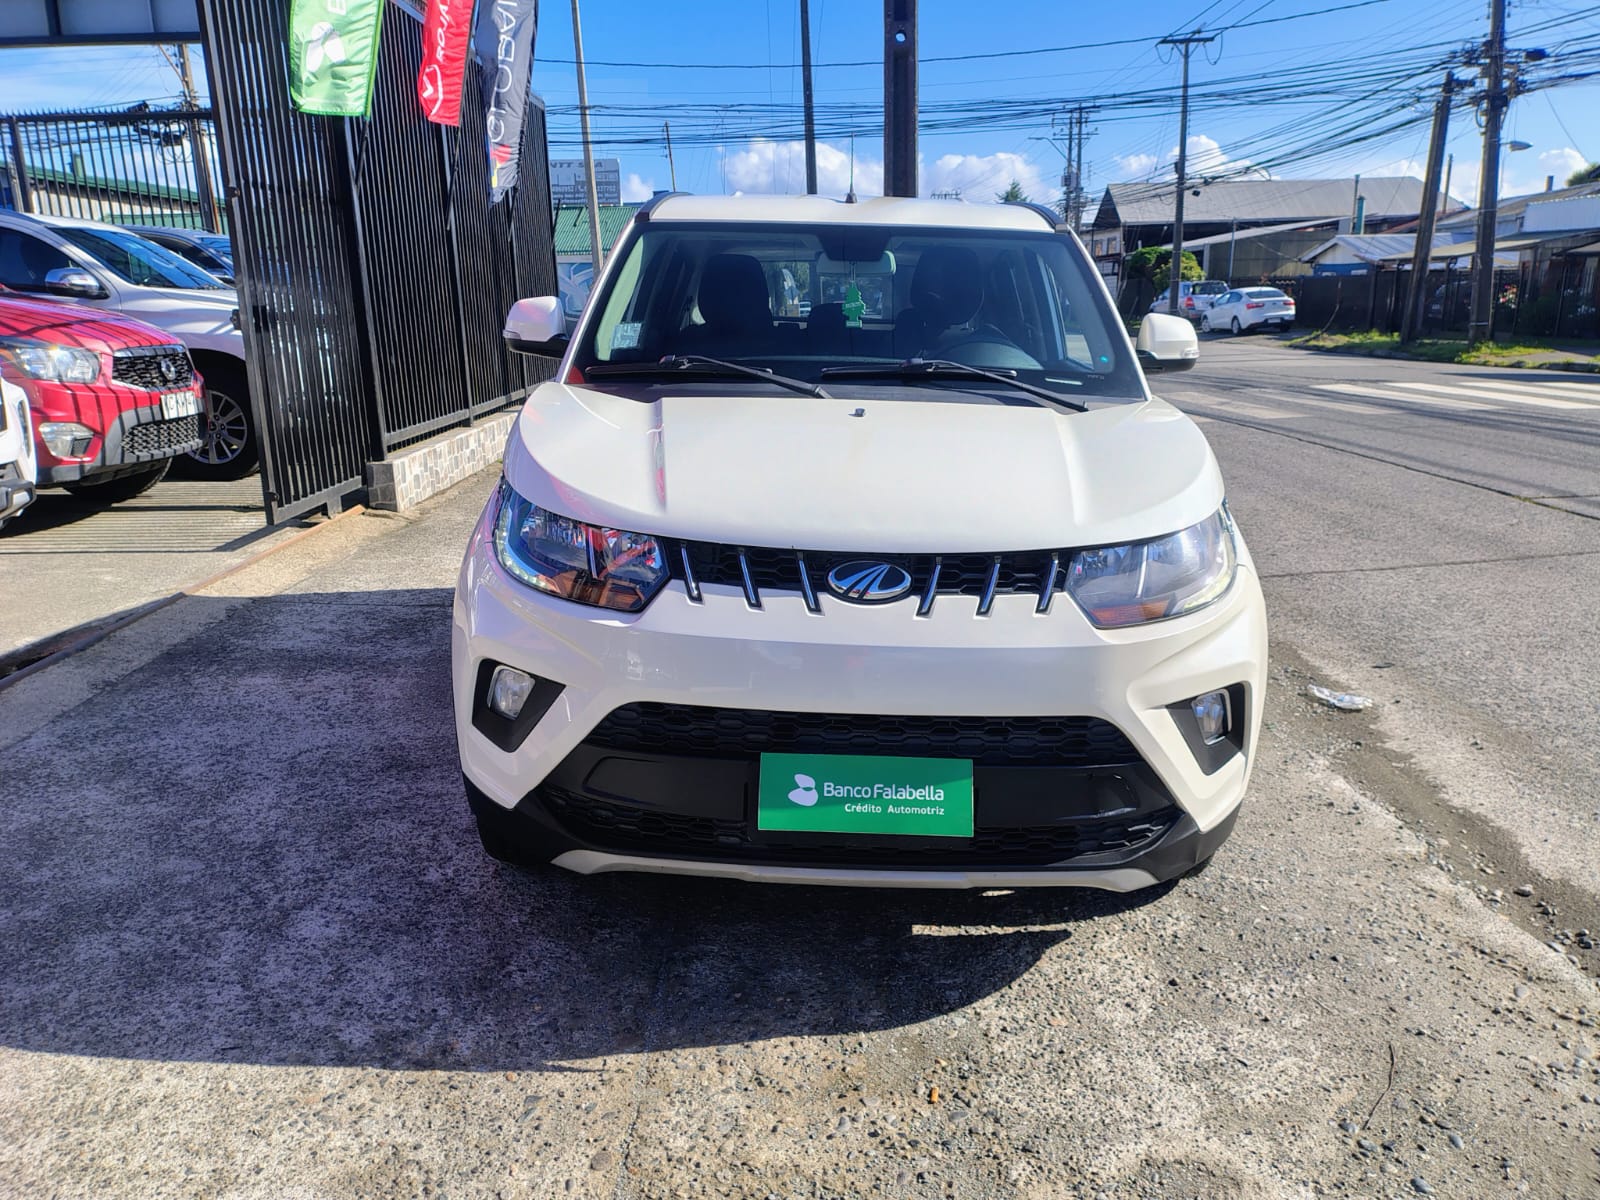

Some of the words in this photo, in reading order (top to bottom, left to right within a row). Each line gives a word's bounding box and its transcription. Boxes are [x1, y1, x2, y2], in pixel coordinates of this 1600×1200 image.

[823, 782, 871, 799] Banco
[873, 784, 944, 801] Falabella
[844, 803, 882, 813] Crédito
[887, 804, 945, 816] Automotriz
